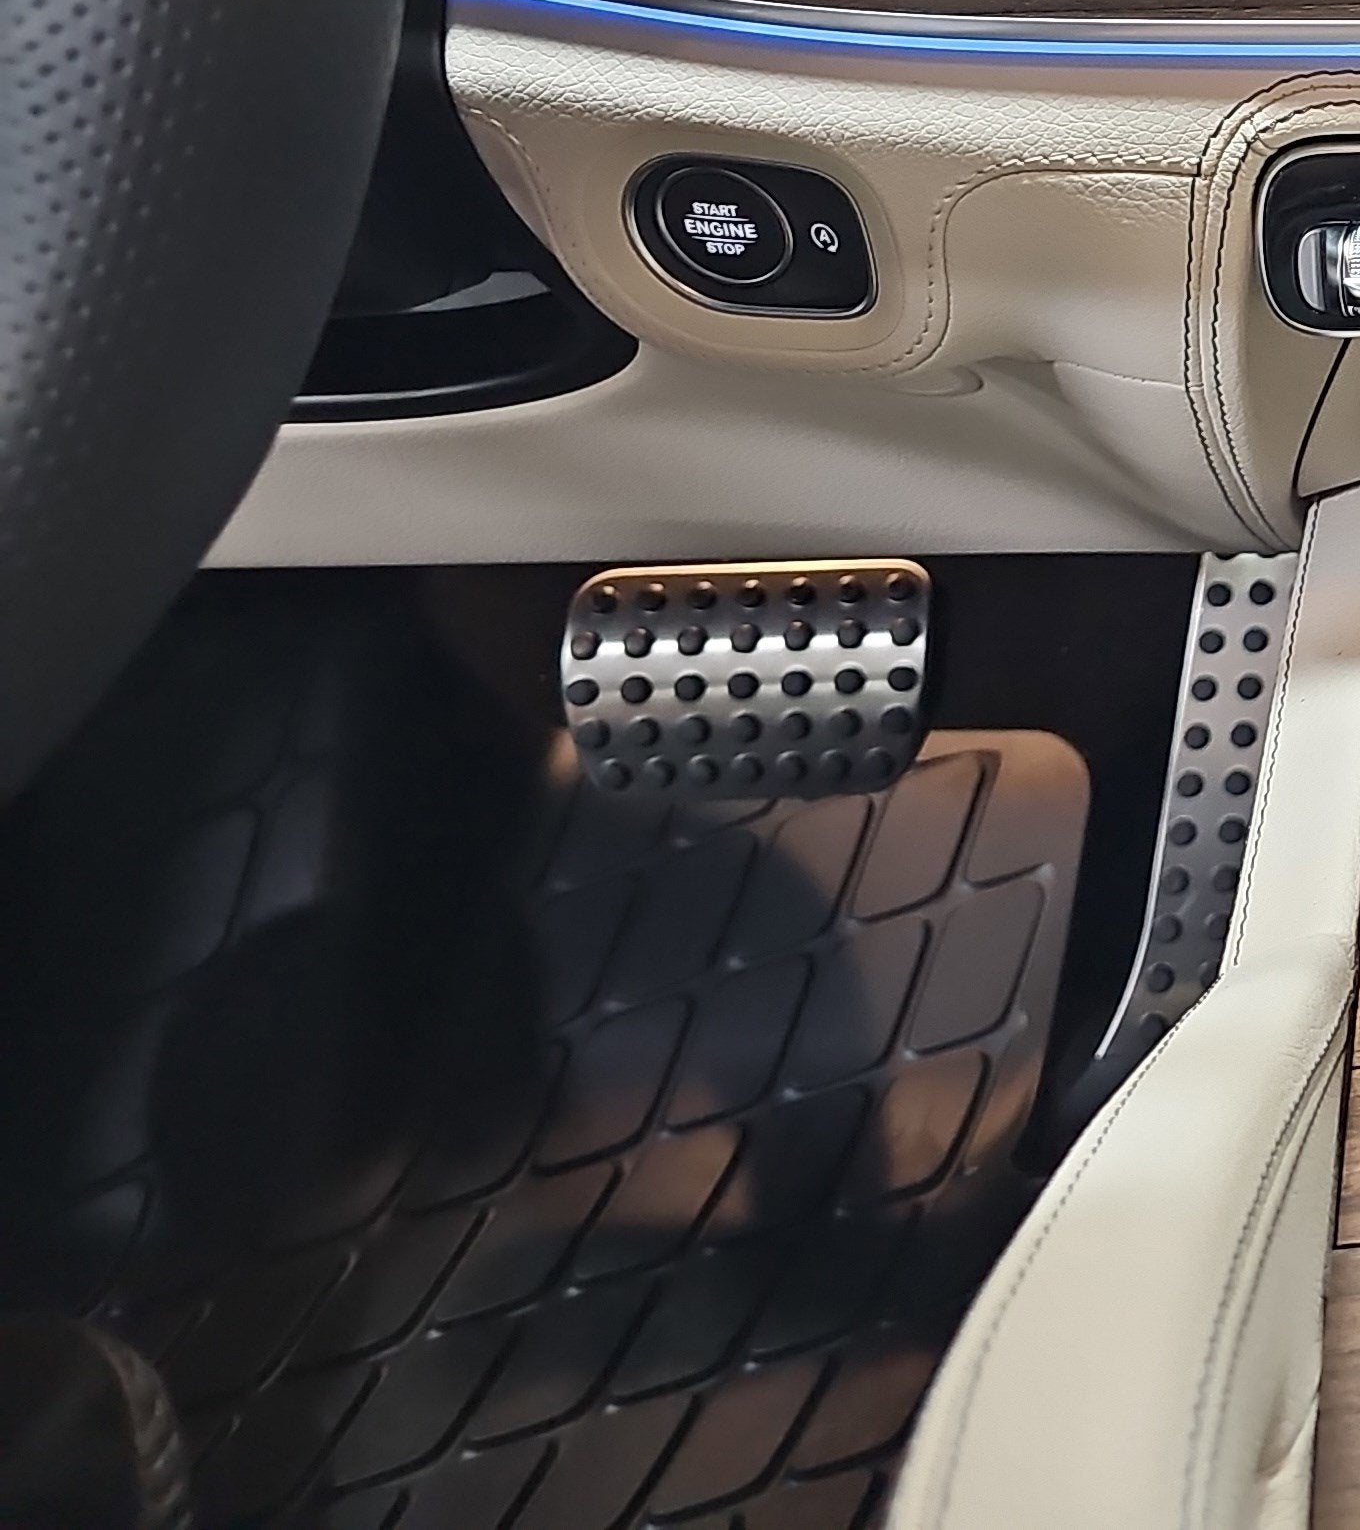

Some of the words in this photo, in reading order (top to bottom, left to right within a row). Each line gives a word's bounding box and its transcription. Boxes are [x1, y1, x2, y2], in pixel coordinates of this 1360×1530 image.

[692, 202, 738, 217] START
[684, 218, 758, 238] ENGINE
[706, 241, 745, 255] STOP
